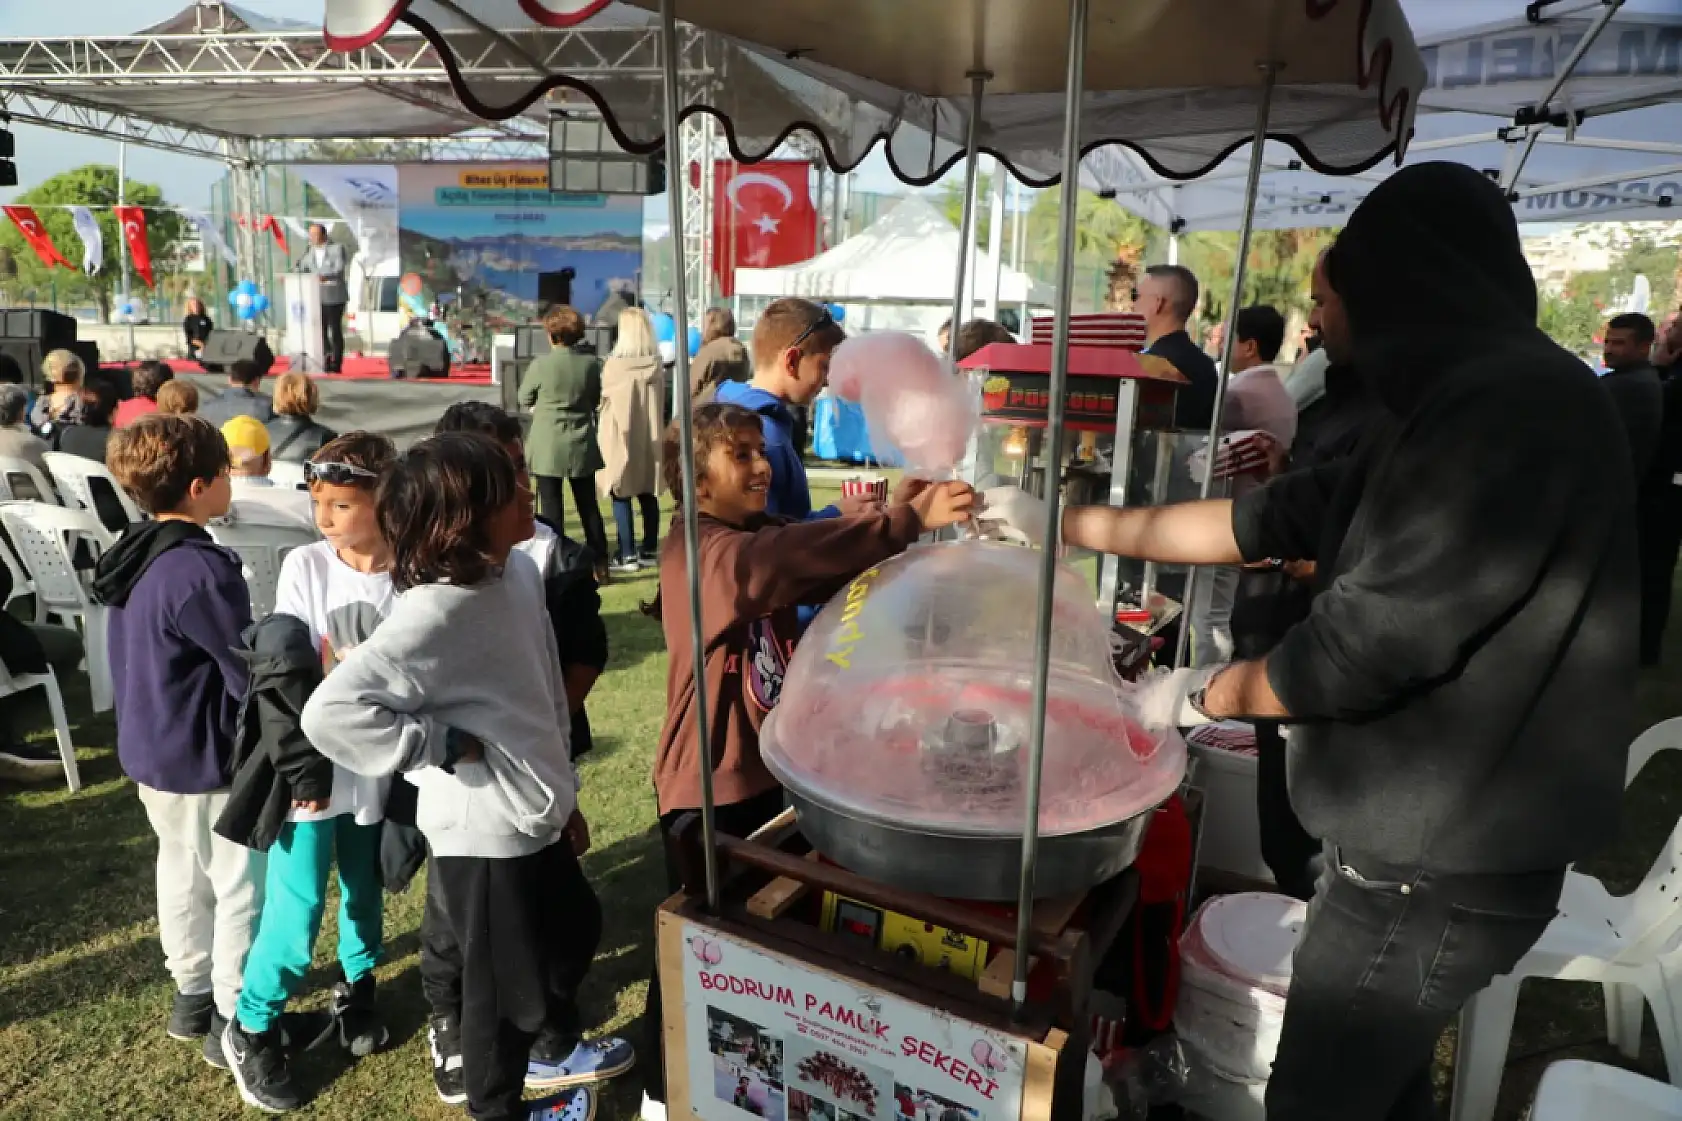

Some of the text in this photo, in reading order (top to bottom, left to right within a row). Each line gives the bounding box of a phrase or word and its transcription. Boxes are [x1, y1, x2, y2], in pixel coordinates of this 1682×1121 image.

[698, 970, 1000, 1101] BODRUM PAMUK ŞEKERİ
